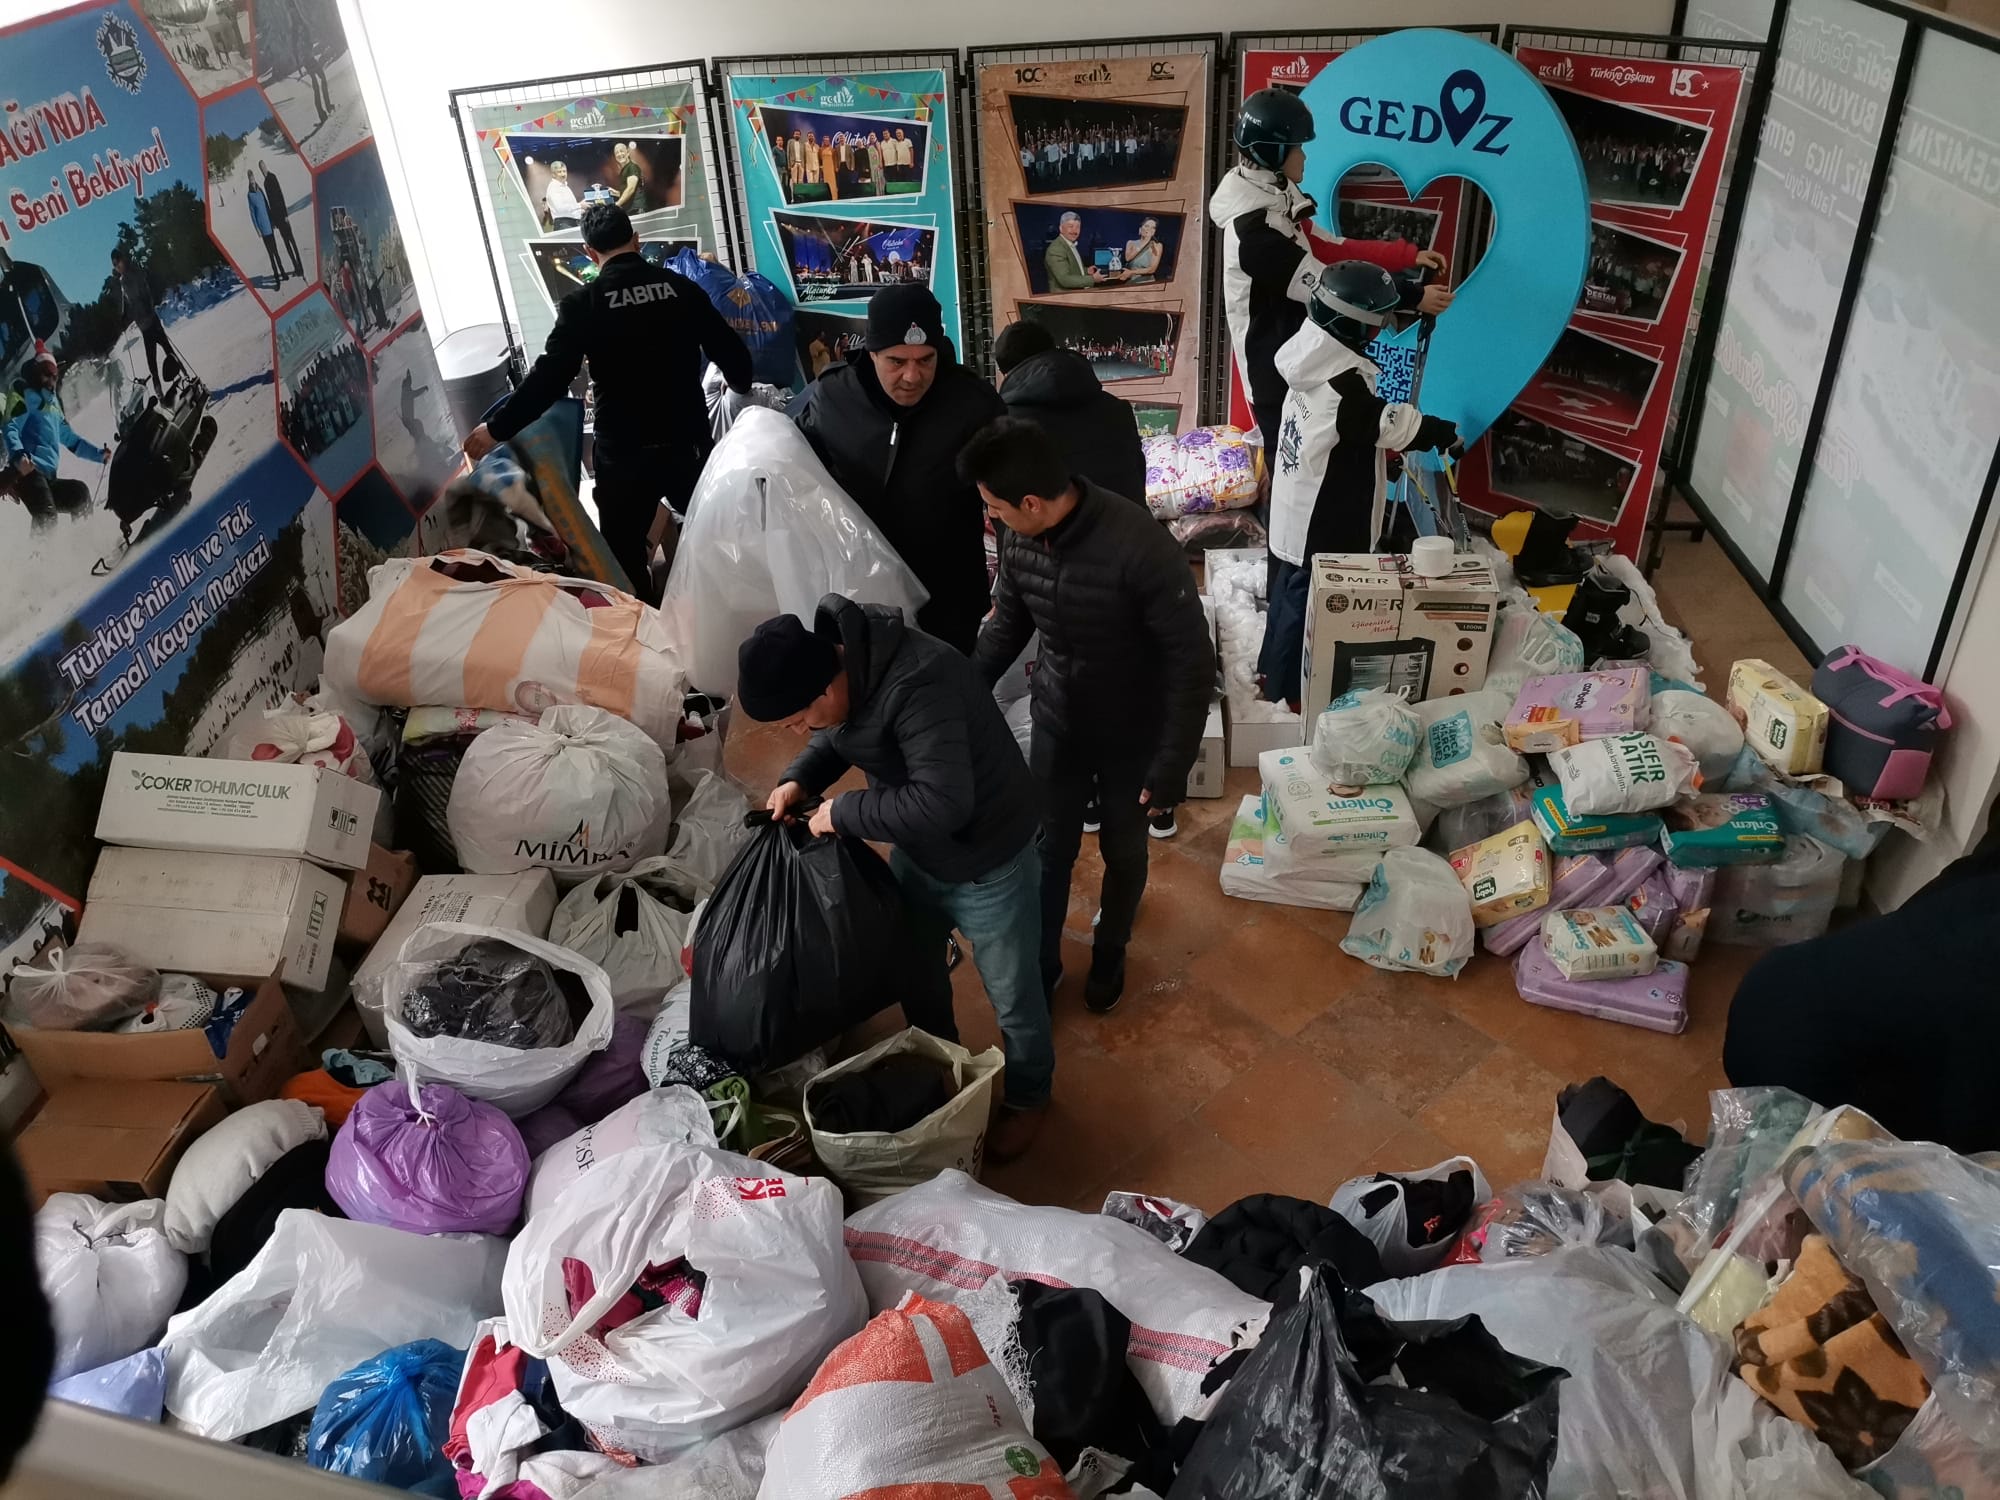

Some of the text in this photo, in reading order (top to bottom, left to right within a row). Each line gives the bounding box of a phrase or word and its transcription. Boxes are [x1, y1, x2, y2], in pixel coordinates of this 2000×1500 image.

[12, 130, 170, 231] Seni Bekliyor!
[605, 282, 678, 309] ZABITA
[60, 500, 254, 689] Türkiye'nin İlk ve Tek
[72, 535, 272, 737] Termal Kayak Merkezi
[1621, 745, 1652, 786] ATIK
[1639, 731, 1665, 783] SIFIR
[194, 779, 291, 800] TOHUMCULUK
[1327, 797, 1393, 813] Önlem
